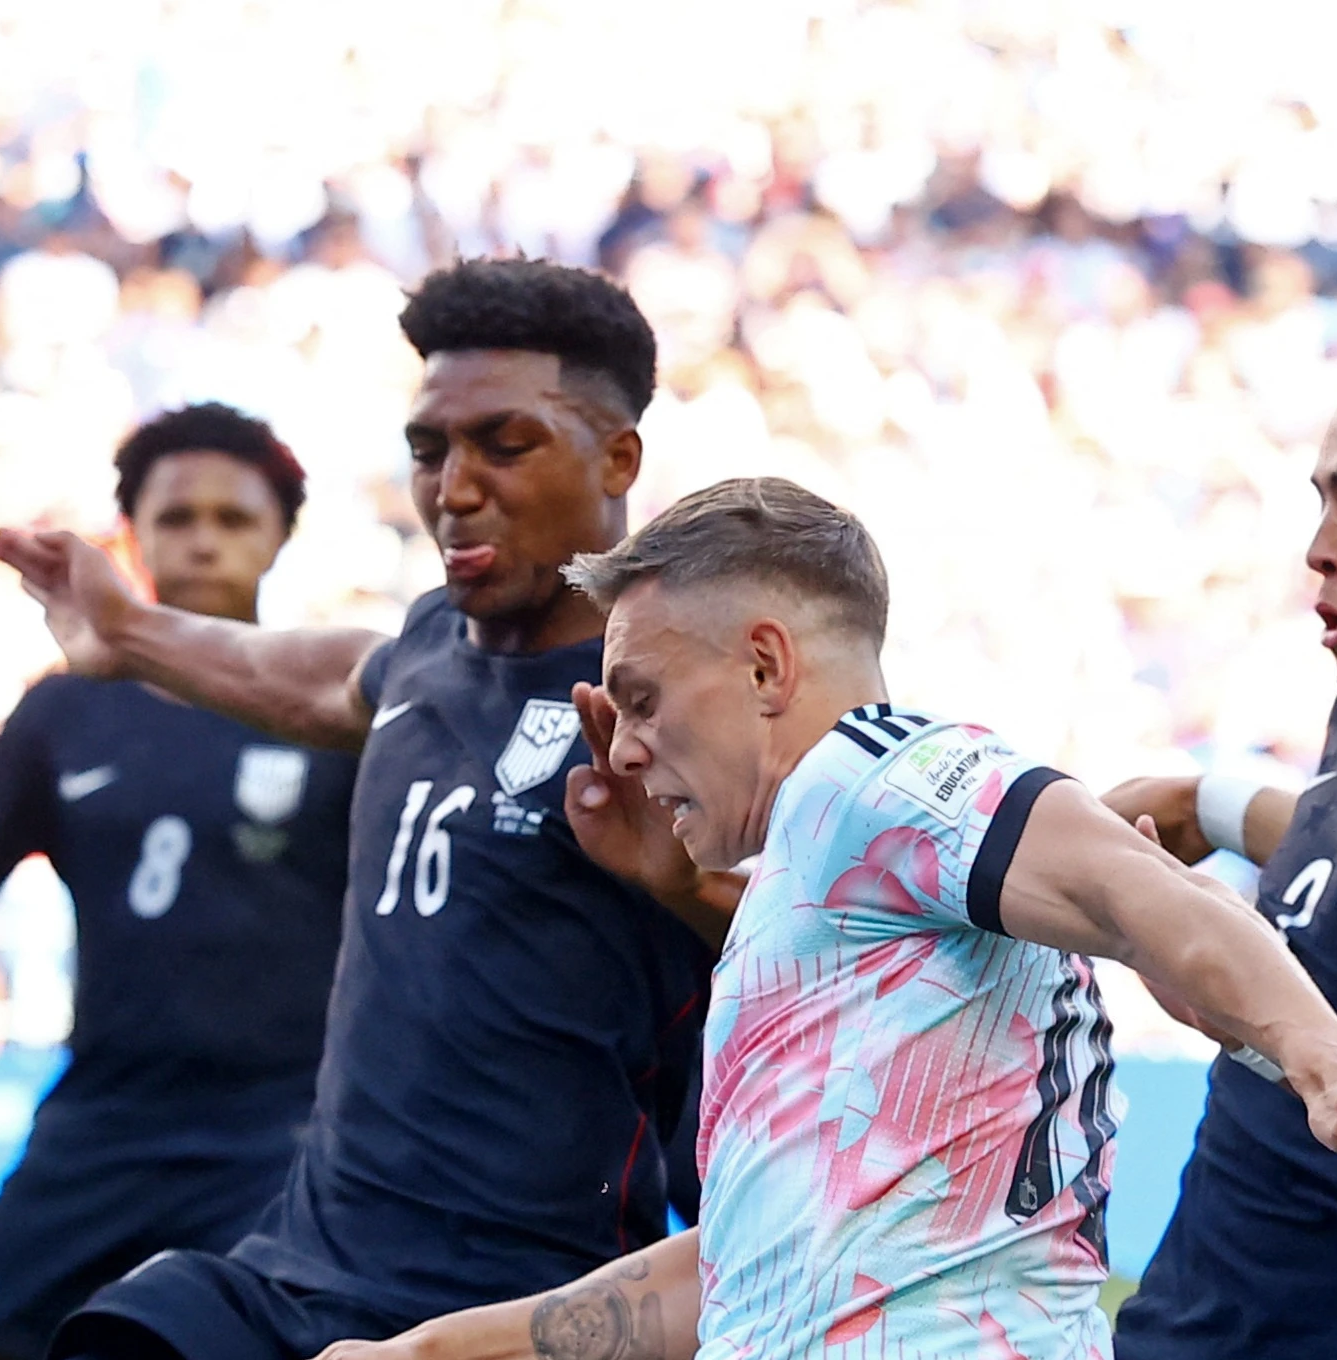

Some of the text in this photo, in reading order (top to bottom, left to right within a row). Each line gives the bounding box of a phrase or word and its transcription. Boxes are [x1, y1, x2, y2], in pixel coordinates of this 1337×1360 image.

[522, 707, 580, 744] USA
[935, 750, 980, 802] EDUCATION
[128, 814, 192, 919] 8
[375, 779, 477, 917] 16
